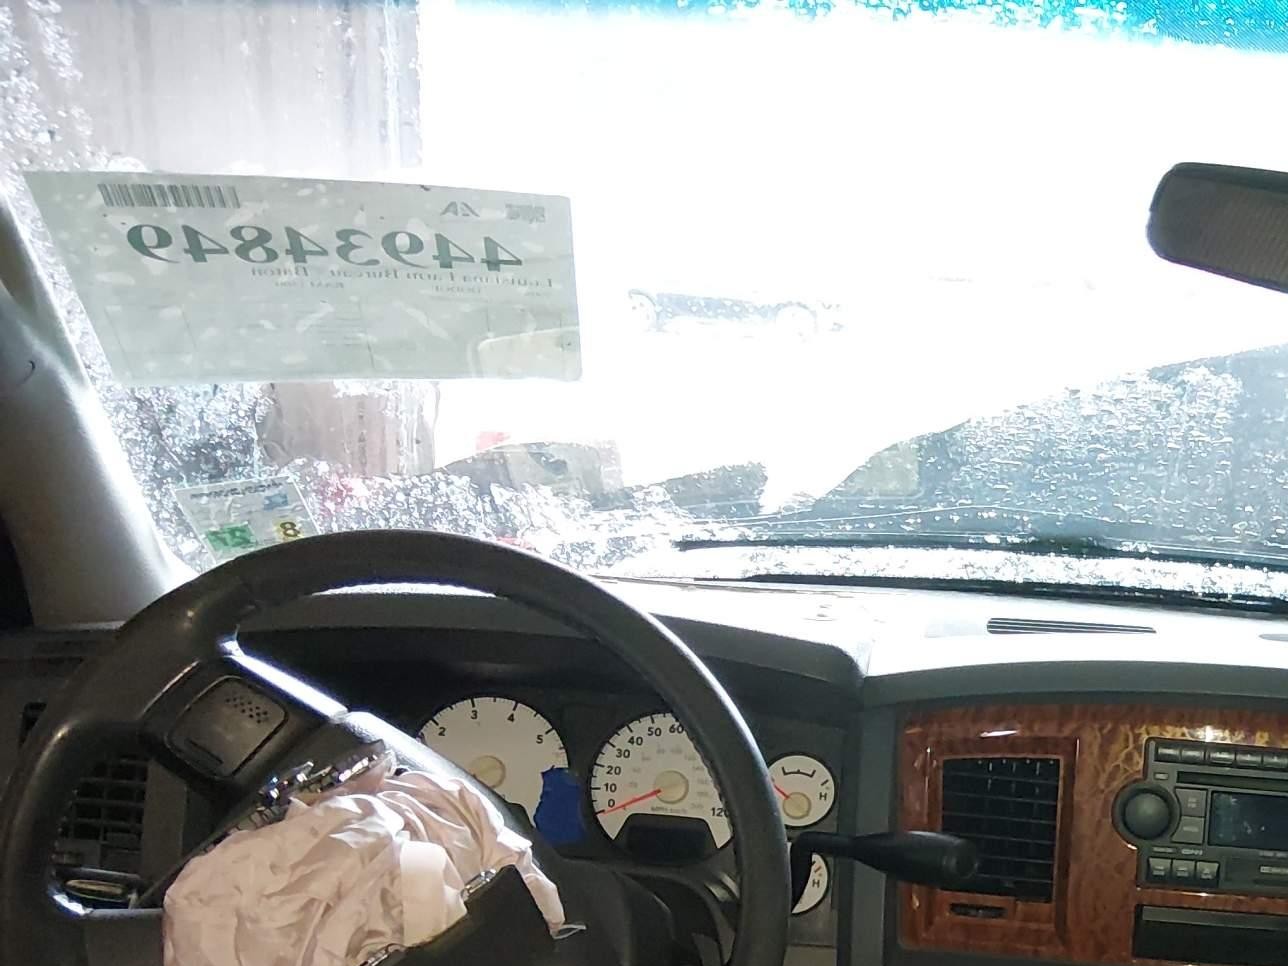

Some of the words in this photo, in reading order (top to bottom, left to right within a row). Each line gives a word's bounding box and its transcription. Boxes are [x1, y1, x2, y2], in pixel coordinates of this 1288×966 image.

[471, 710, 478, 720] 3
[507, 713, 515, 722] 4
[438, 727, 446, 736] 2
[647, 727, 662, 737] 50
[668, 724, 684, 734] 60
[536, 735, 544, 744] 5
[628, 736, 643, 746] 40
[616, 748, 631, 759] 30
[606, 766, 621, 775] 20
[604, 782, 617, 793] 10
[819, 792, 828, 801] H
[608, 799, 615, 808] 0
[812, 879, 820, 888] H
